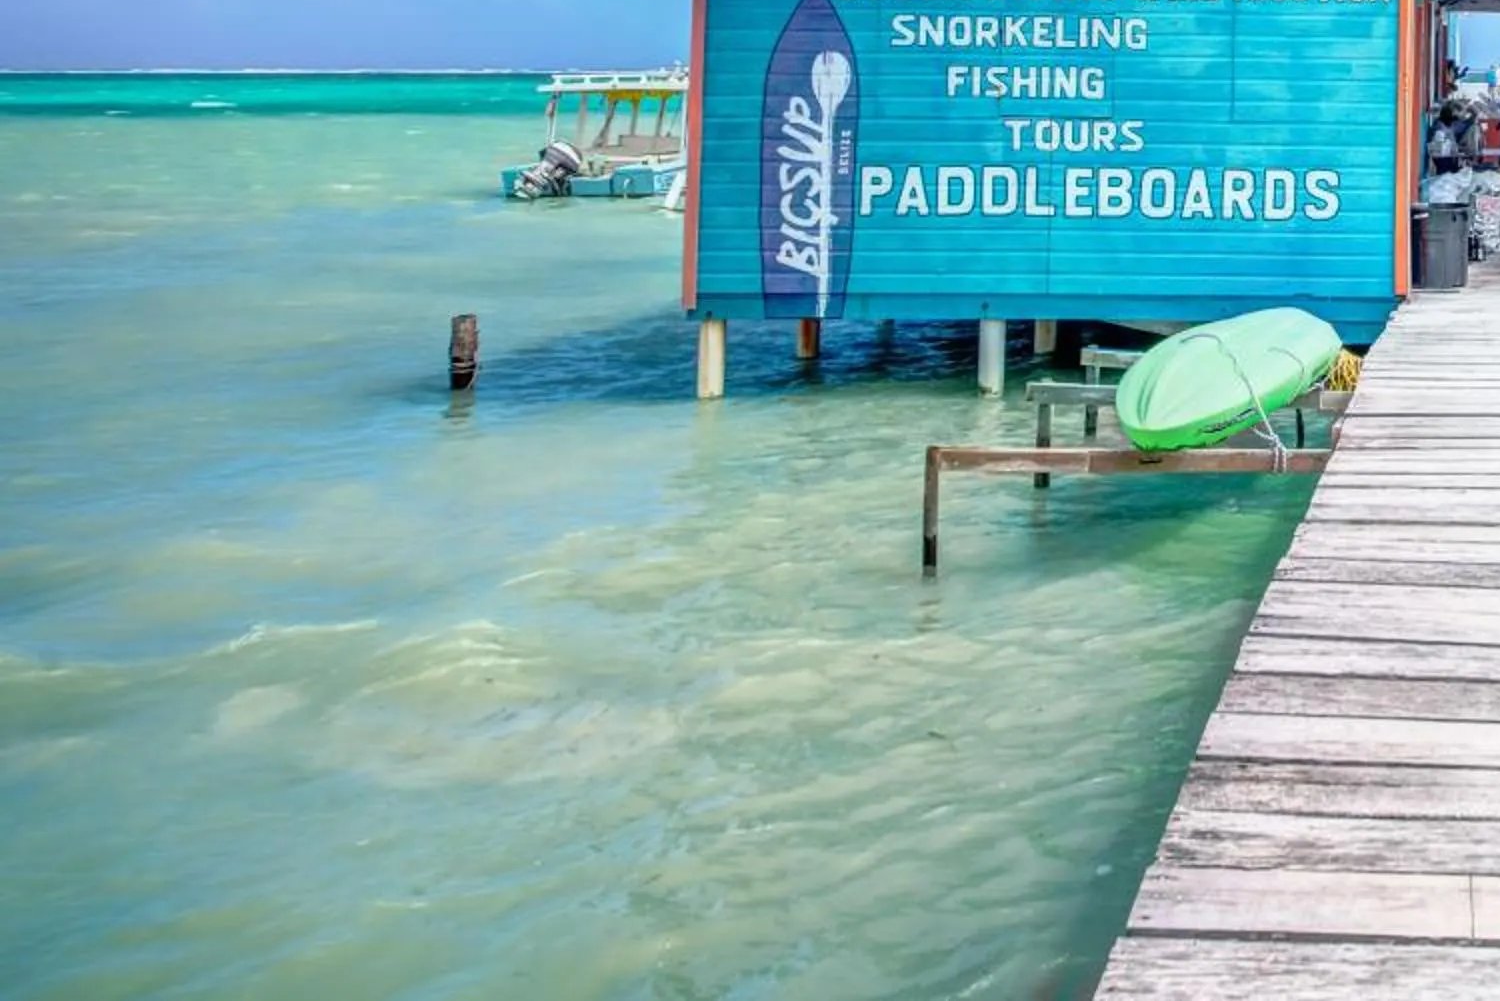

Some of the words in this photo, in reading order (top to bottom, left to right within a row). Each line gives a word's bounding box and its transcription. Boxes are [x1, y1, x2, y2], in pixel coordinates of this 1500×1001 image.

[890, 13, 1149, 51] SNORKELING
[946, 65, 1106, 100] FISHING
[1003, 117, 1145, 152] TOURS
[859, 165, 1341, 221] PADDLEBOARDS
